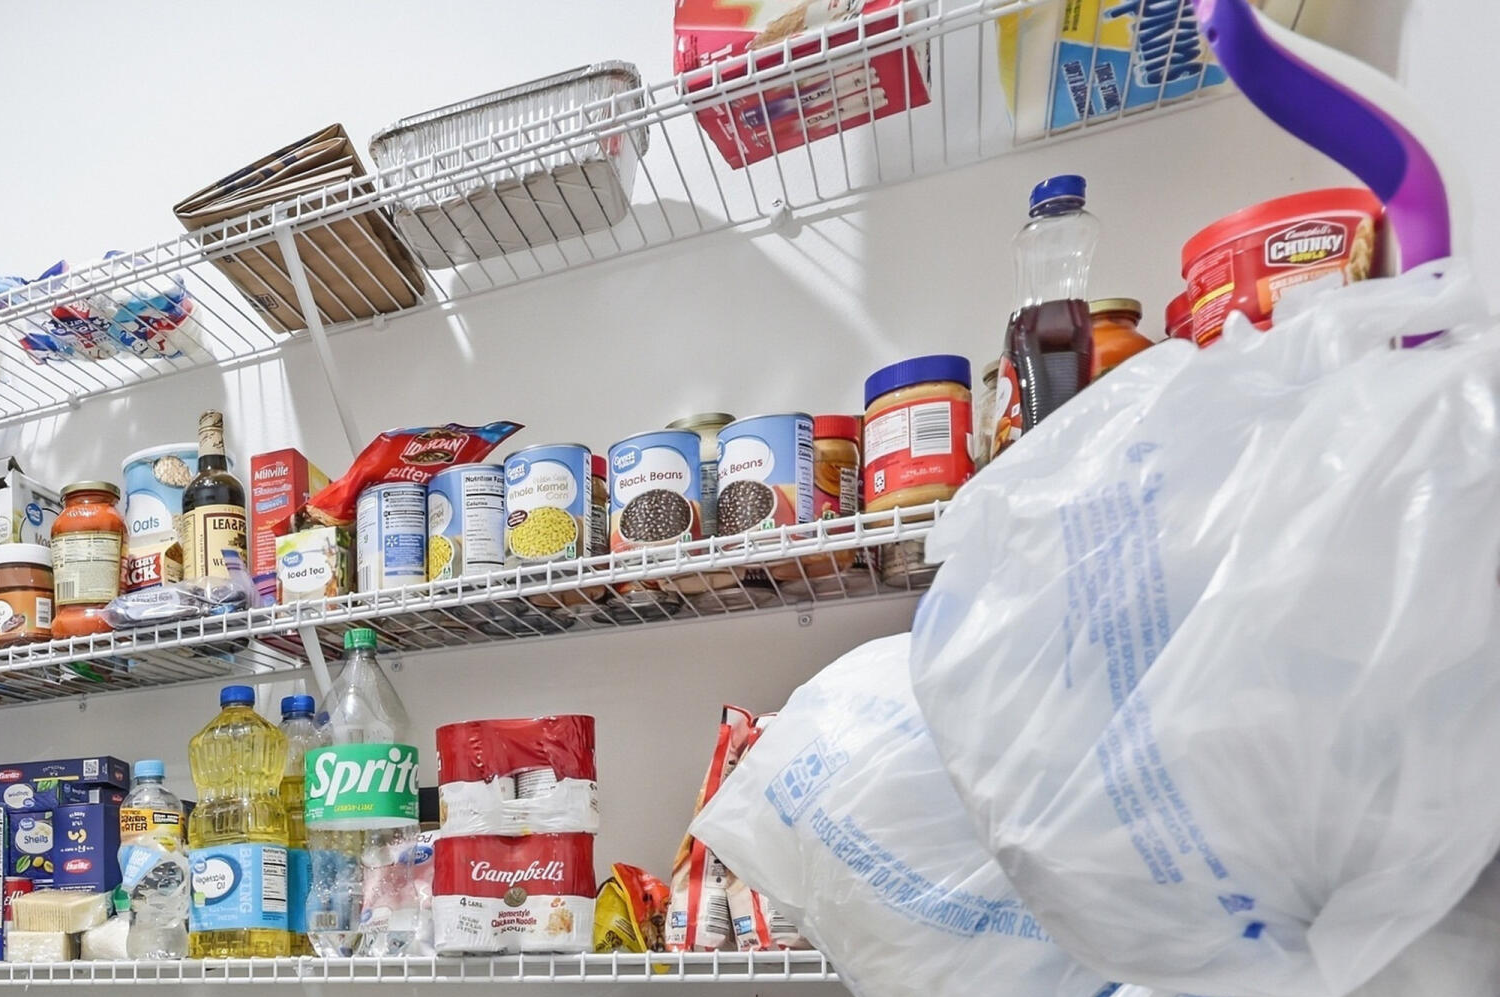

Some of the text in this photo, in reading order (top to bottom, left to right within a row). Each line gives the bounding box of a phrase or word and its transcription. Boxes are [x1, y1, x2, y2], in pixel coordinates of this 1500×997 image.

[1270, 234, 1343, 261] CHUNKY
[729, 457, 764, 475] Beans
[618, 468, 684, 490] Black Beans
[536, 481, 570, 493] Kernel
[545, 491, 570, 501] Corn
[132, 516, 160, 533] Oats
[212, 518, 229, 531] LEA
[288, 566, 325, 580] Iced Tea
[24, 835, 49, 845] Shells
[470, 860, 565, 888] Campbell's
[809, 807, 840, 848] PLEASE
[832, 839, 875, 876] RETURN
[869, 865, 890, 887] TO
[883, 873, 898, 895] A
[892, 880, 979, 933] PARTICIPATING
[216, 881, 226, 890] Oil
[239, 848, 252, 914] BAKING
[460, 897, 483, 908] 4 CANS
[491, 919, 515, 928] Chicken
[500, 926, 526, 934] SOUP
